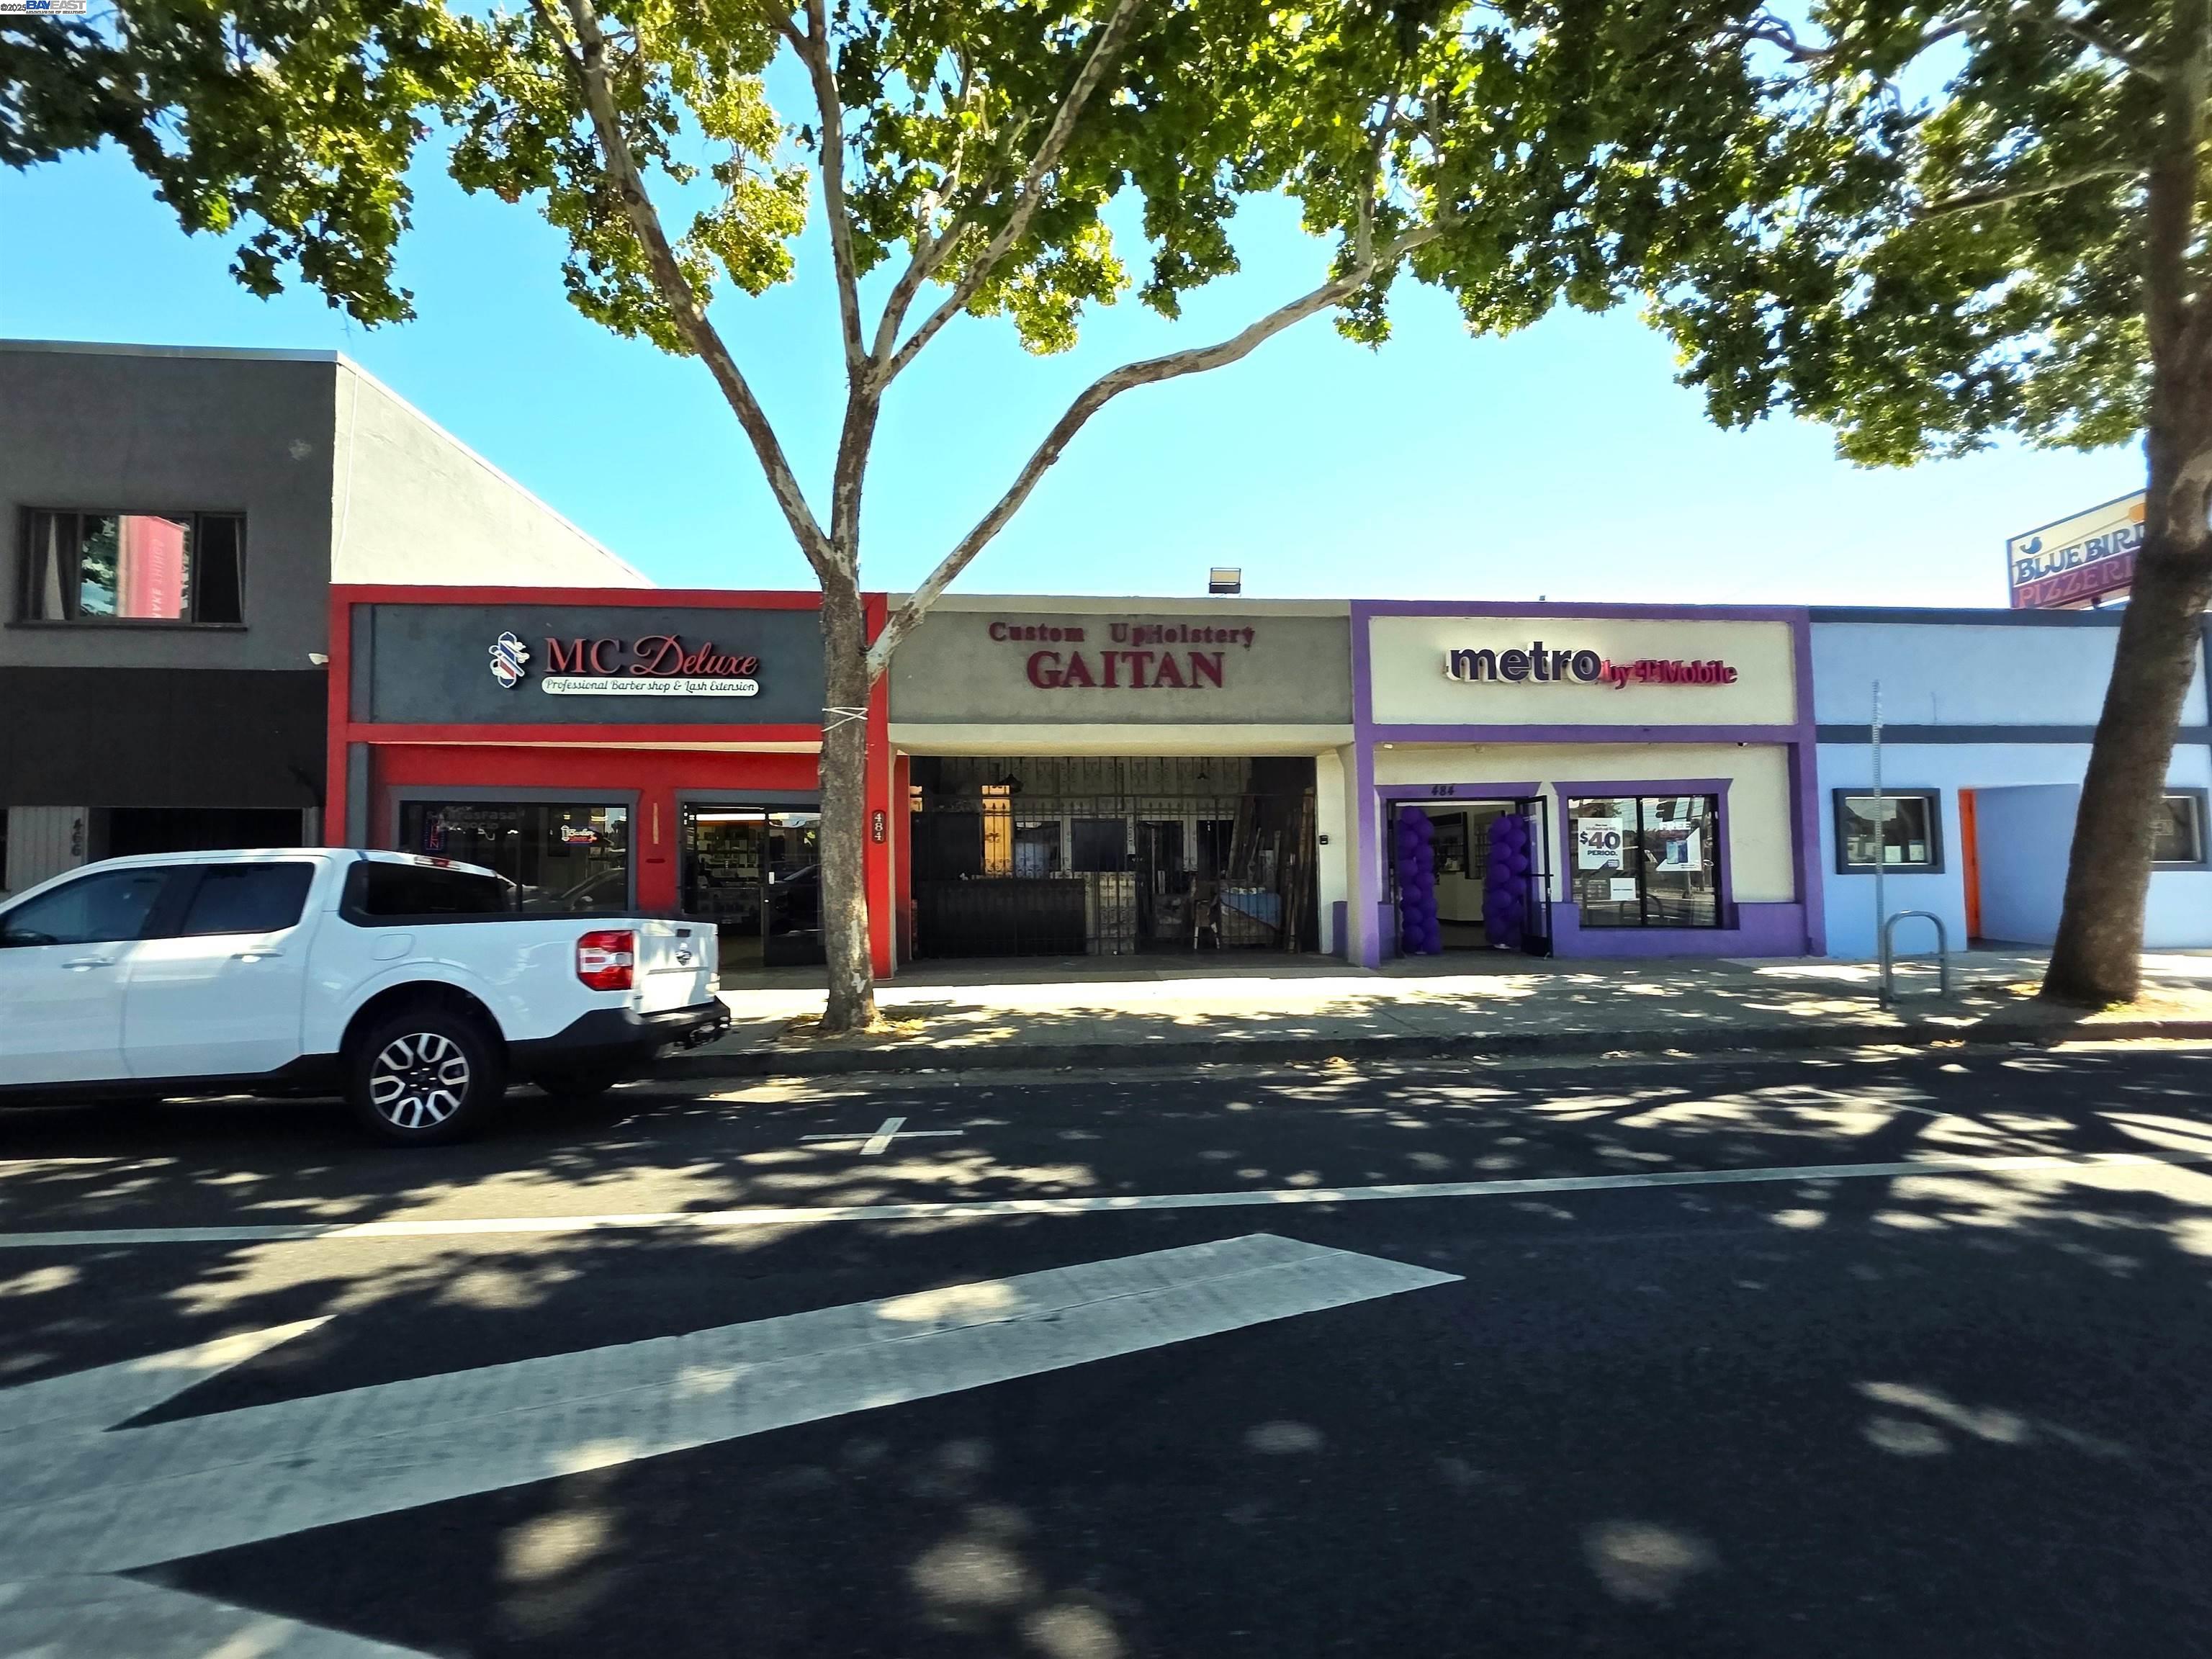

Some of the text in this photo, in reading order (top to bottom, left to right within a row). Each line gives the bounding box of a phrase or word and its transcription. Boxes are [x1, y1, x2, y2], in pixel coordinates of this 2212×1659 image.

[2015, 544, 2083, 585] BLUE
[2018, 555, 2135, 608] PIZZERI
[989, 622, 1084, 642] Custom
[543, 634, 759, 676] MC Deluxe
[1027, 650, 1226, 689] GAITAN
[1447, 640, 1602, 683] metro
[1601, 659, 1635, 689] by
[546, 679, 755, 693] Professional Barber shop & Lash Extension
[1431, 785, 1455, 796] 484
[873, 813, 883, 841] 484
[1579, 831, 1621, 850] $40
